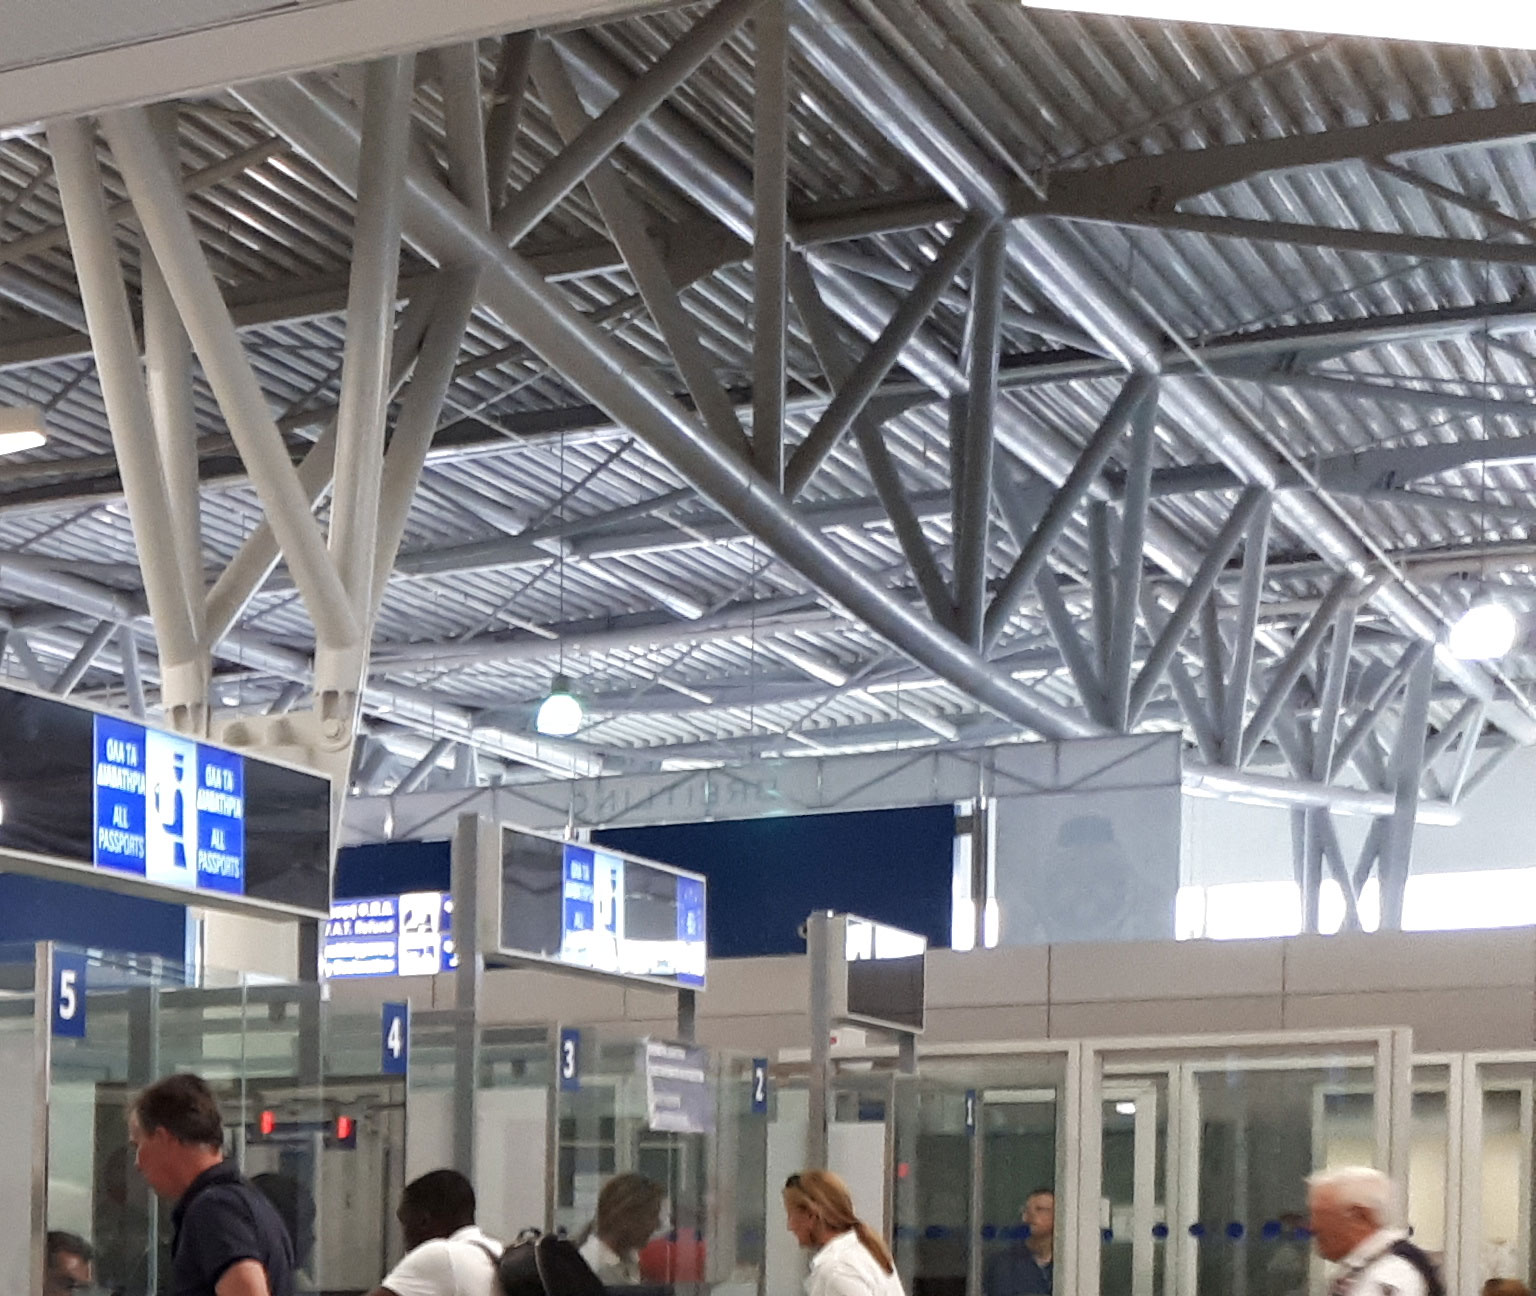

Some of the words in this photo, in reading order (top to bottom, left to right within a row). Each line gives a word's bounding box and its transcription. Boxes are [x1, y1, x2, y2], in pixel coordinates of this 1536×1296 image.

[113, 804, 129, 829] ALL
[98, 826, 145, 859] PASSPORTS
[210, 828, 226, 851] ALL
[198, 849, 240, 879] PASSPORTS
[58, 969, 77, 1020] 5
[387, 1016, 402, 1059] 4
[562, 1039, 576, 1078] 3
[755, 1067, 765, 1103] 2
[967, 1098, 973, 1125] 1
